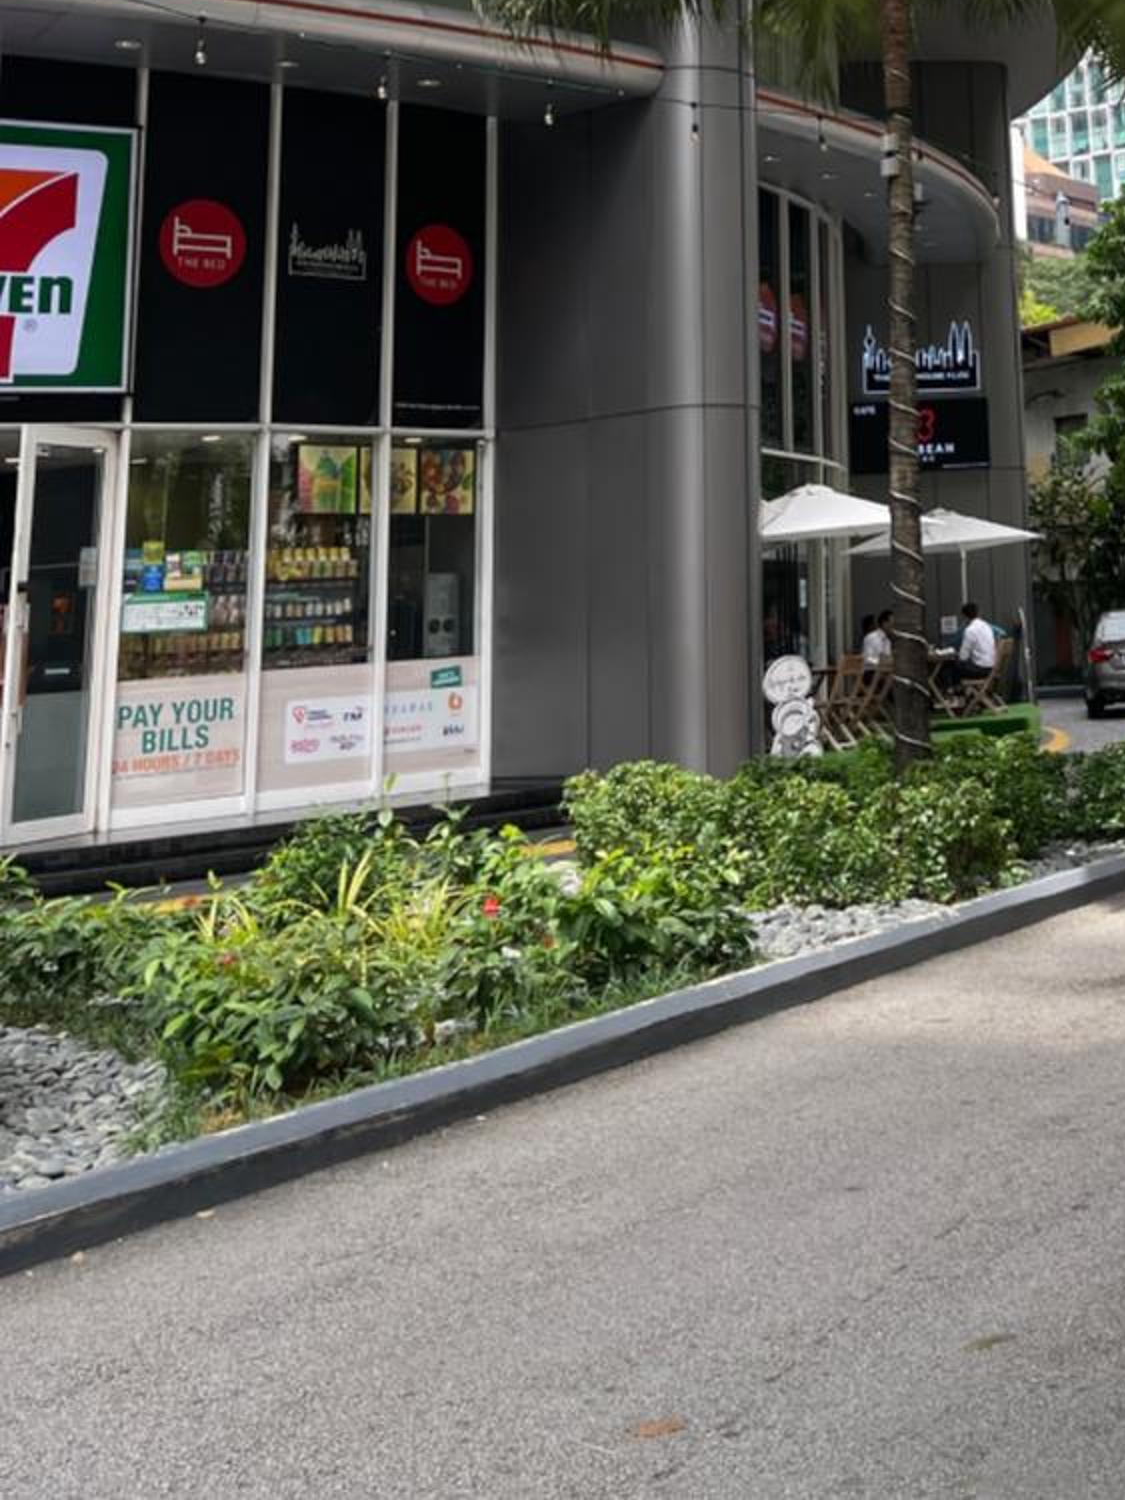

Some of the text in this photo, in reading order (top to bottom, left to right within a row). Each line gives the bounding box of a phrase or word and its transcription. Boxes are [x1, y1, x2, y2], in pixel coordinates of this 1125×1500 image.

[117, 697, 234, 729] PAY YOUR
[141, 723, 210, 755] BILLS
[131, 753, 182, 773] HOURS
